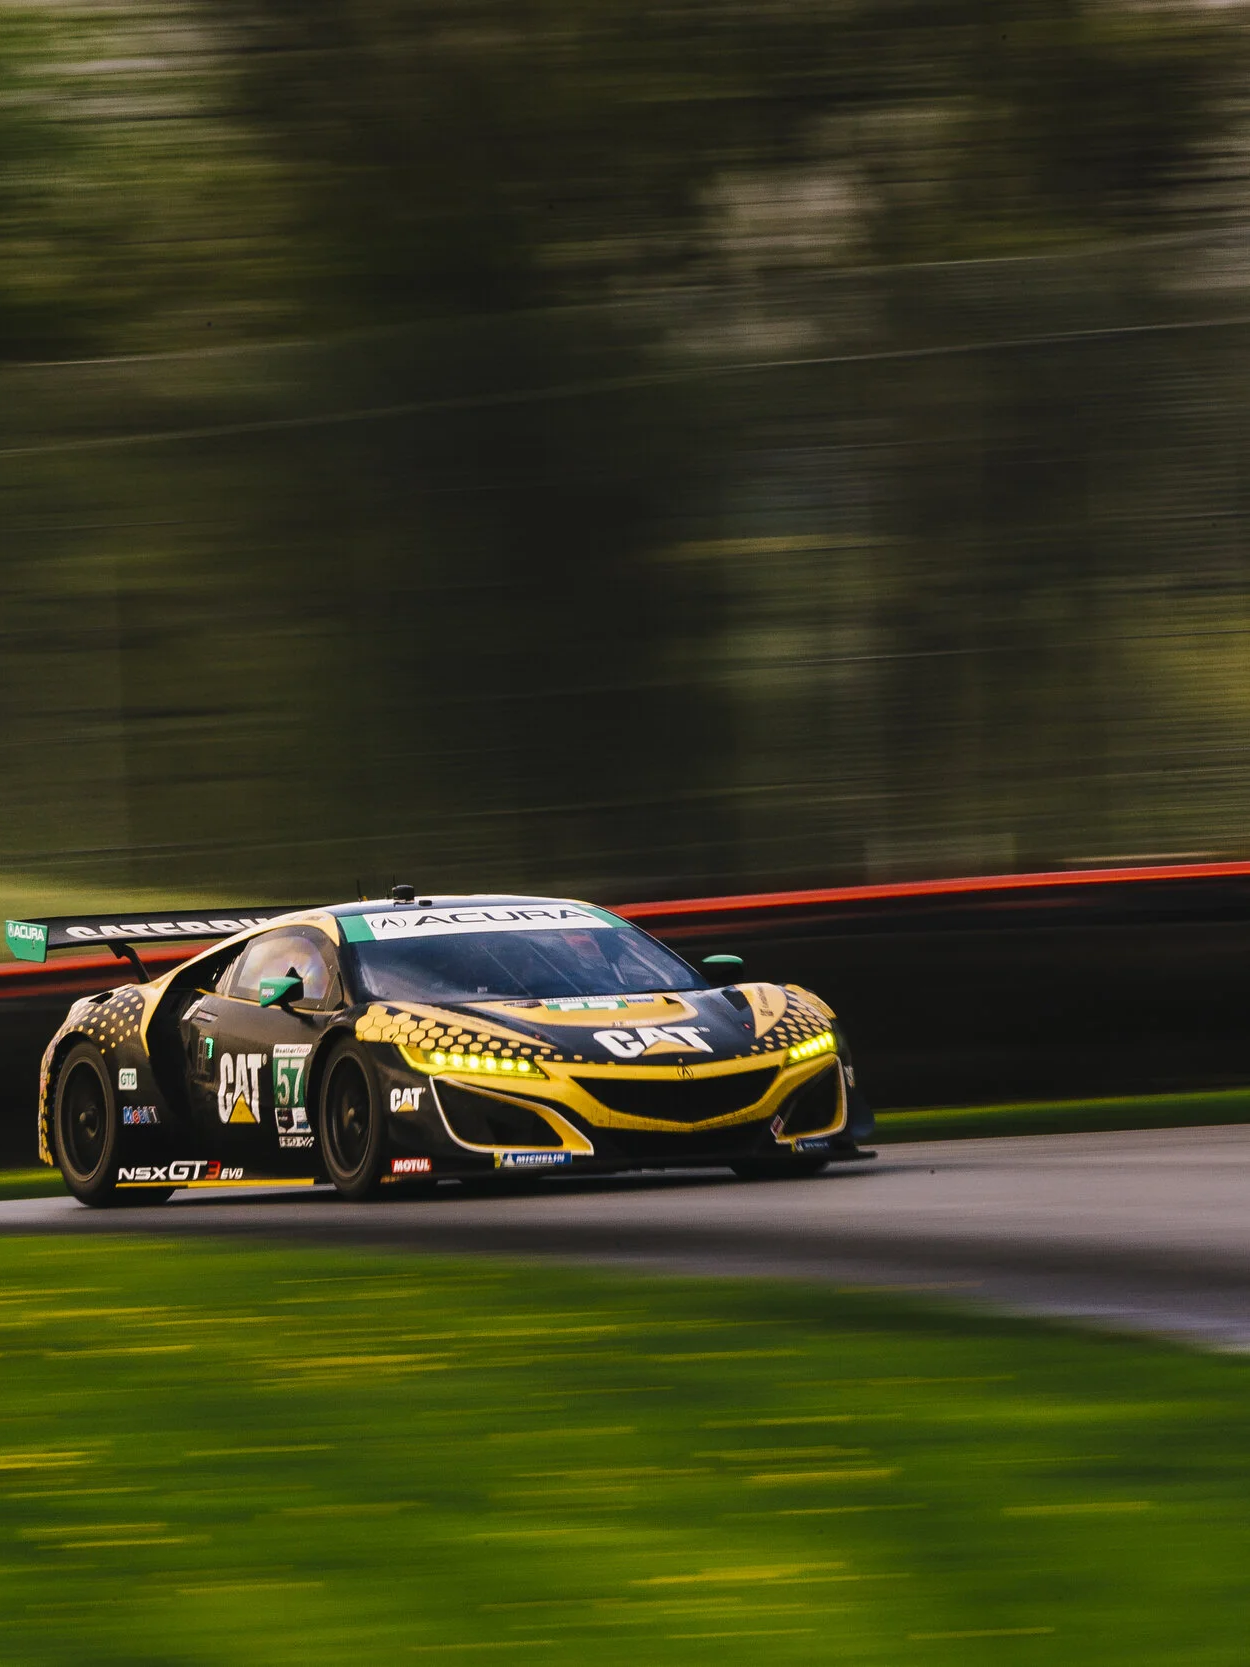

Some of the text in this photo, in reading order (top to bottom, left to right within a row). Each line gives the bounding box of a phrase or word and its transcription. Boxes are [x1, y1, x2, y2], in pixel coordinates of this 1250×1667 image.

[413, 908, 594, 927] ACURA
[14, 924, 44, 941] ACURA
[593, 1026, 714, 1058] CAT
[121, 1072, 135, 1086] GTD
[218, 1053, 261, 1124] CAT
[277, 1059, 305, 1105] 57
[390, 1087, 422, 1112] CAT
[393, 1158, 430, 1173] MOTUL
[516, 1153, 565, 1165] MICHELIN
